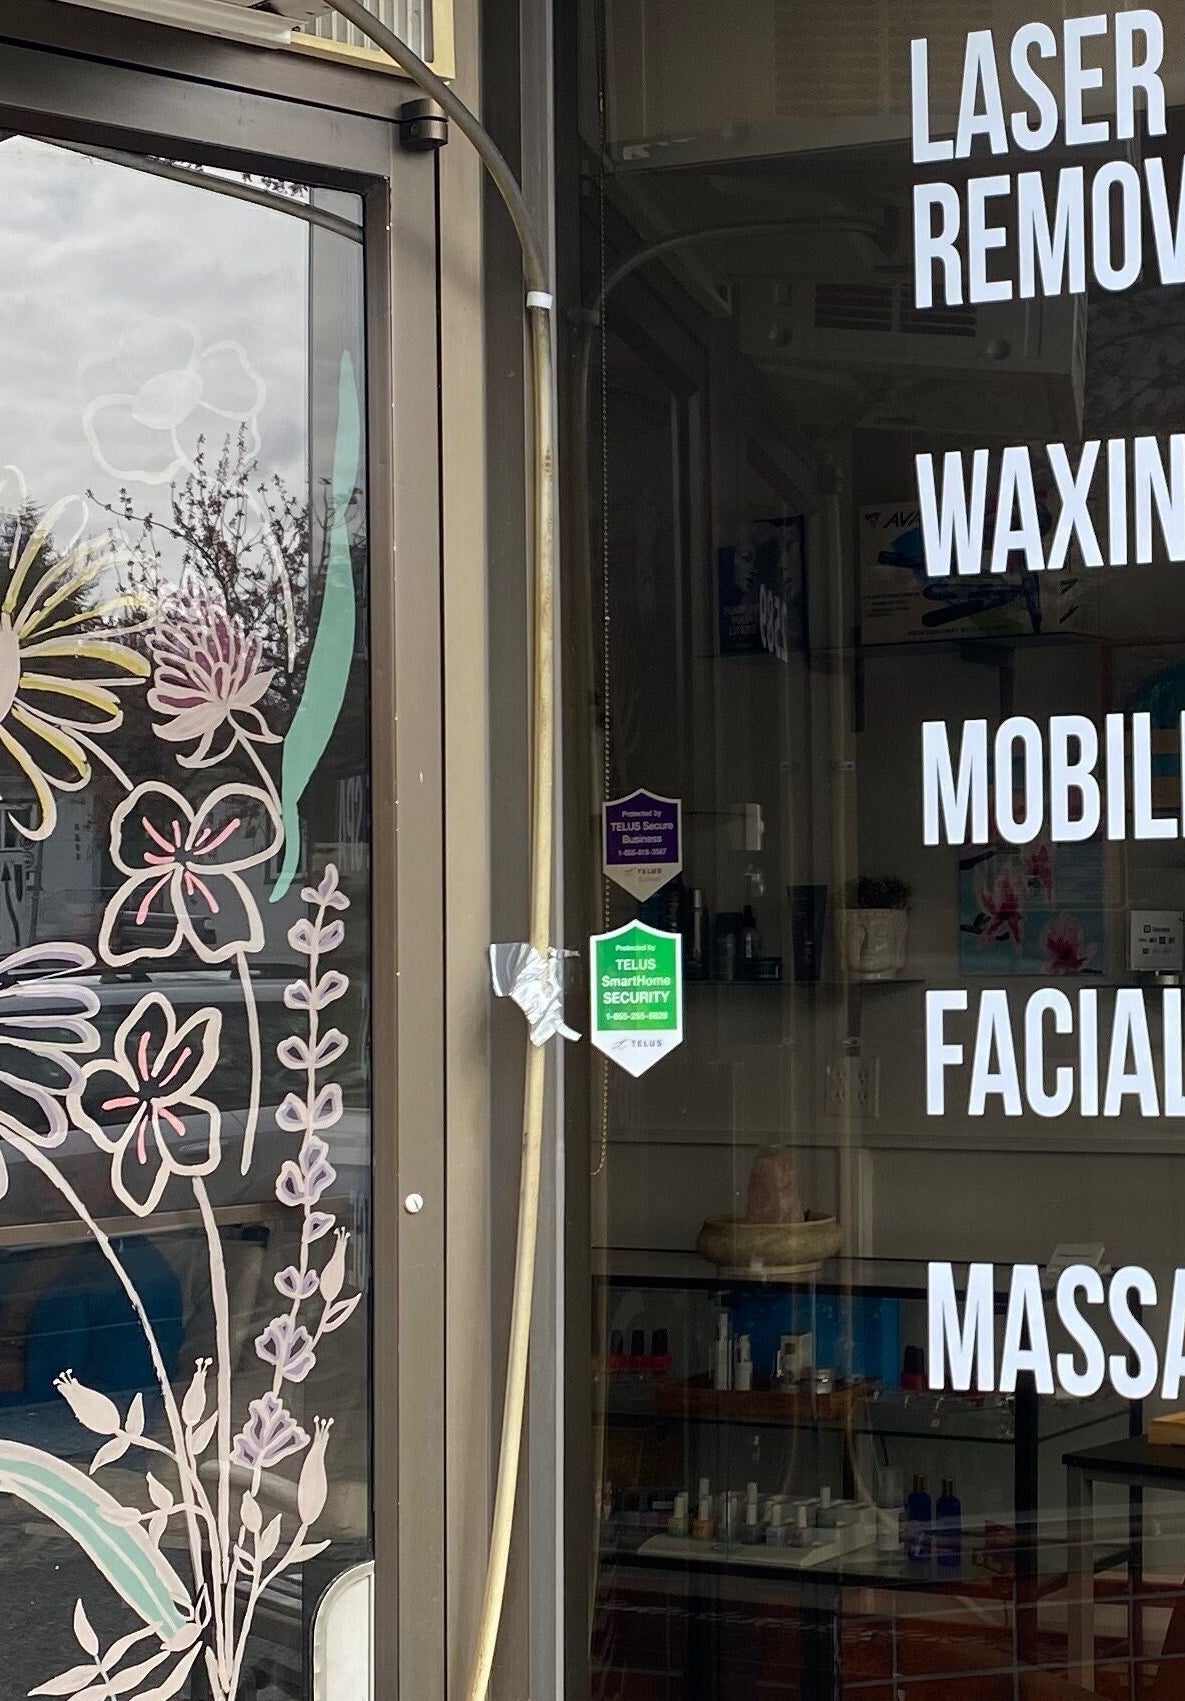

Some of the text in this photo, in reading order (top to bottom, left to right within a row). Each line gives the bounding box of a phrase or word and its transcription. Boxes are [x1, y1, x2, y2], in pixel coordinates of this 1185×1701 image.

[911, 10, 1167, 163] LASER
[610, 821, 674, 832] TELUS Secure
[615, 958, 657, 971] TELUS
[601, 975, 672, 988] SmartHome
[602, 990, 671, 1005] SECURITY
[631, 1039, 664, 1048] TELUS
